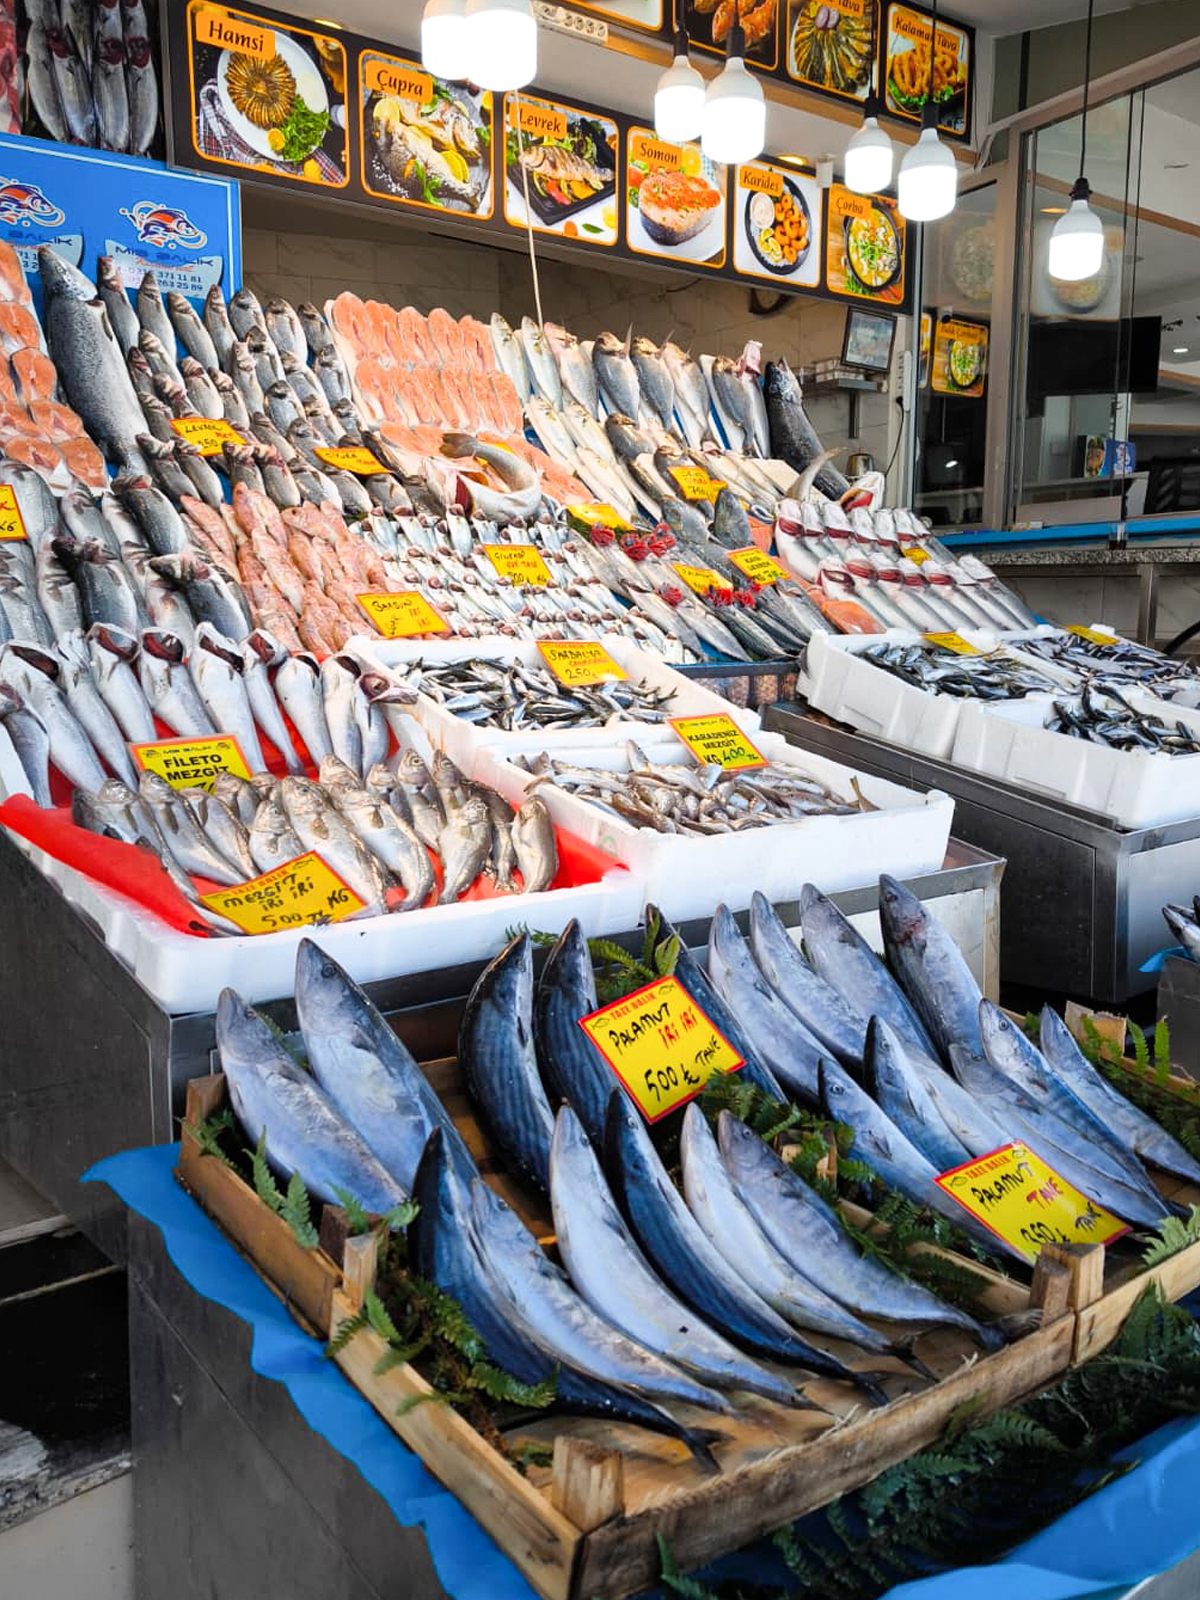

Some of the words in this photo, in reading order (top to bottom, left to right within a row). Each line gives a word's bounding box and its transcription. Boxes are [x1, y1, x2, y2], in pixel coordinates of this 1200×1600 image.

[208, 19, 265, 53] Hamsi
[937, 33, 957, 51] Tava
[376, 69, 423, 97] Çupra
[518, 108, 561, 133] Levrek
[640, 142, 679, 164] Somon
[743, 173, 780, 193] Karides
[836, 196, 864, 215] Çorba
[163, 754, 222, 768] FİLETO
[723, 747, 745, 761] 400
[166, 765, 229, 782] MEZGİT
[223, 873, 297, 908] MEZGİT
[261, 913, 302, 927] 500
[610, 1006, 632, 1021] TAZE
[609, 1002, 671, 1055] PALAMUT
[644, 1066, 679, 1102] 500
[965, 1167, 986, 1180] TAZE
[986, 1156, 1012, 1171] BALIK
[971, 1162, 1034, 1212] PALAMUT
[1026, 1177, 1064, 1210] TANE
